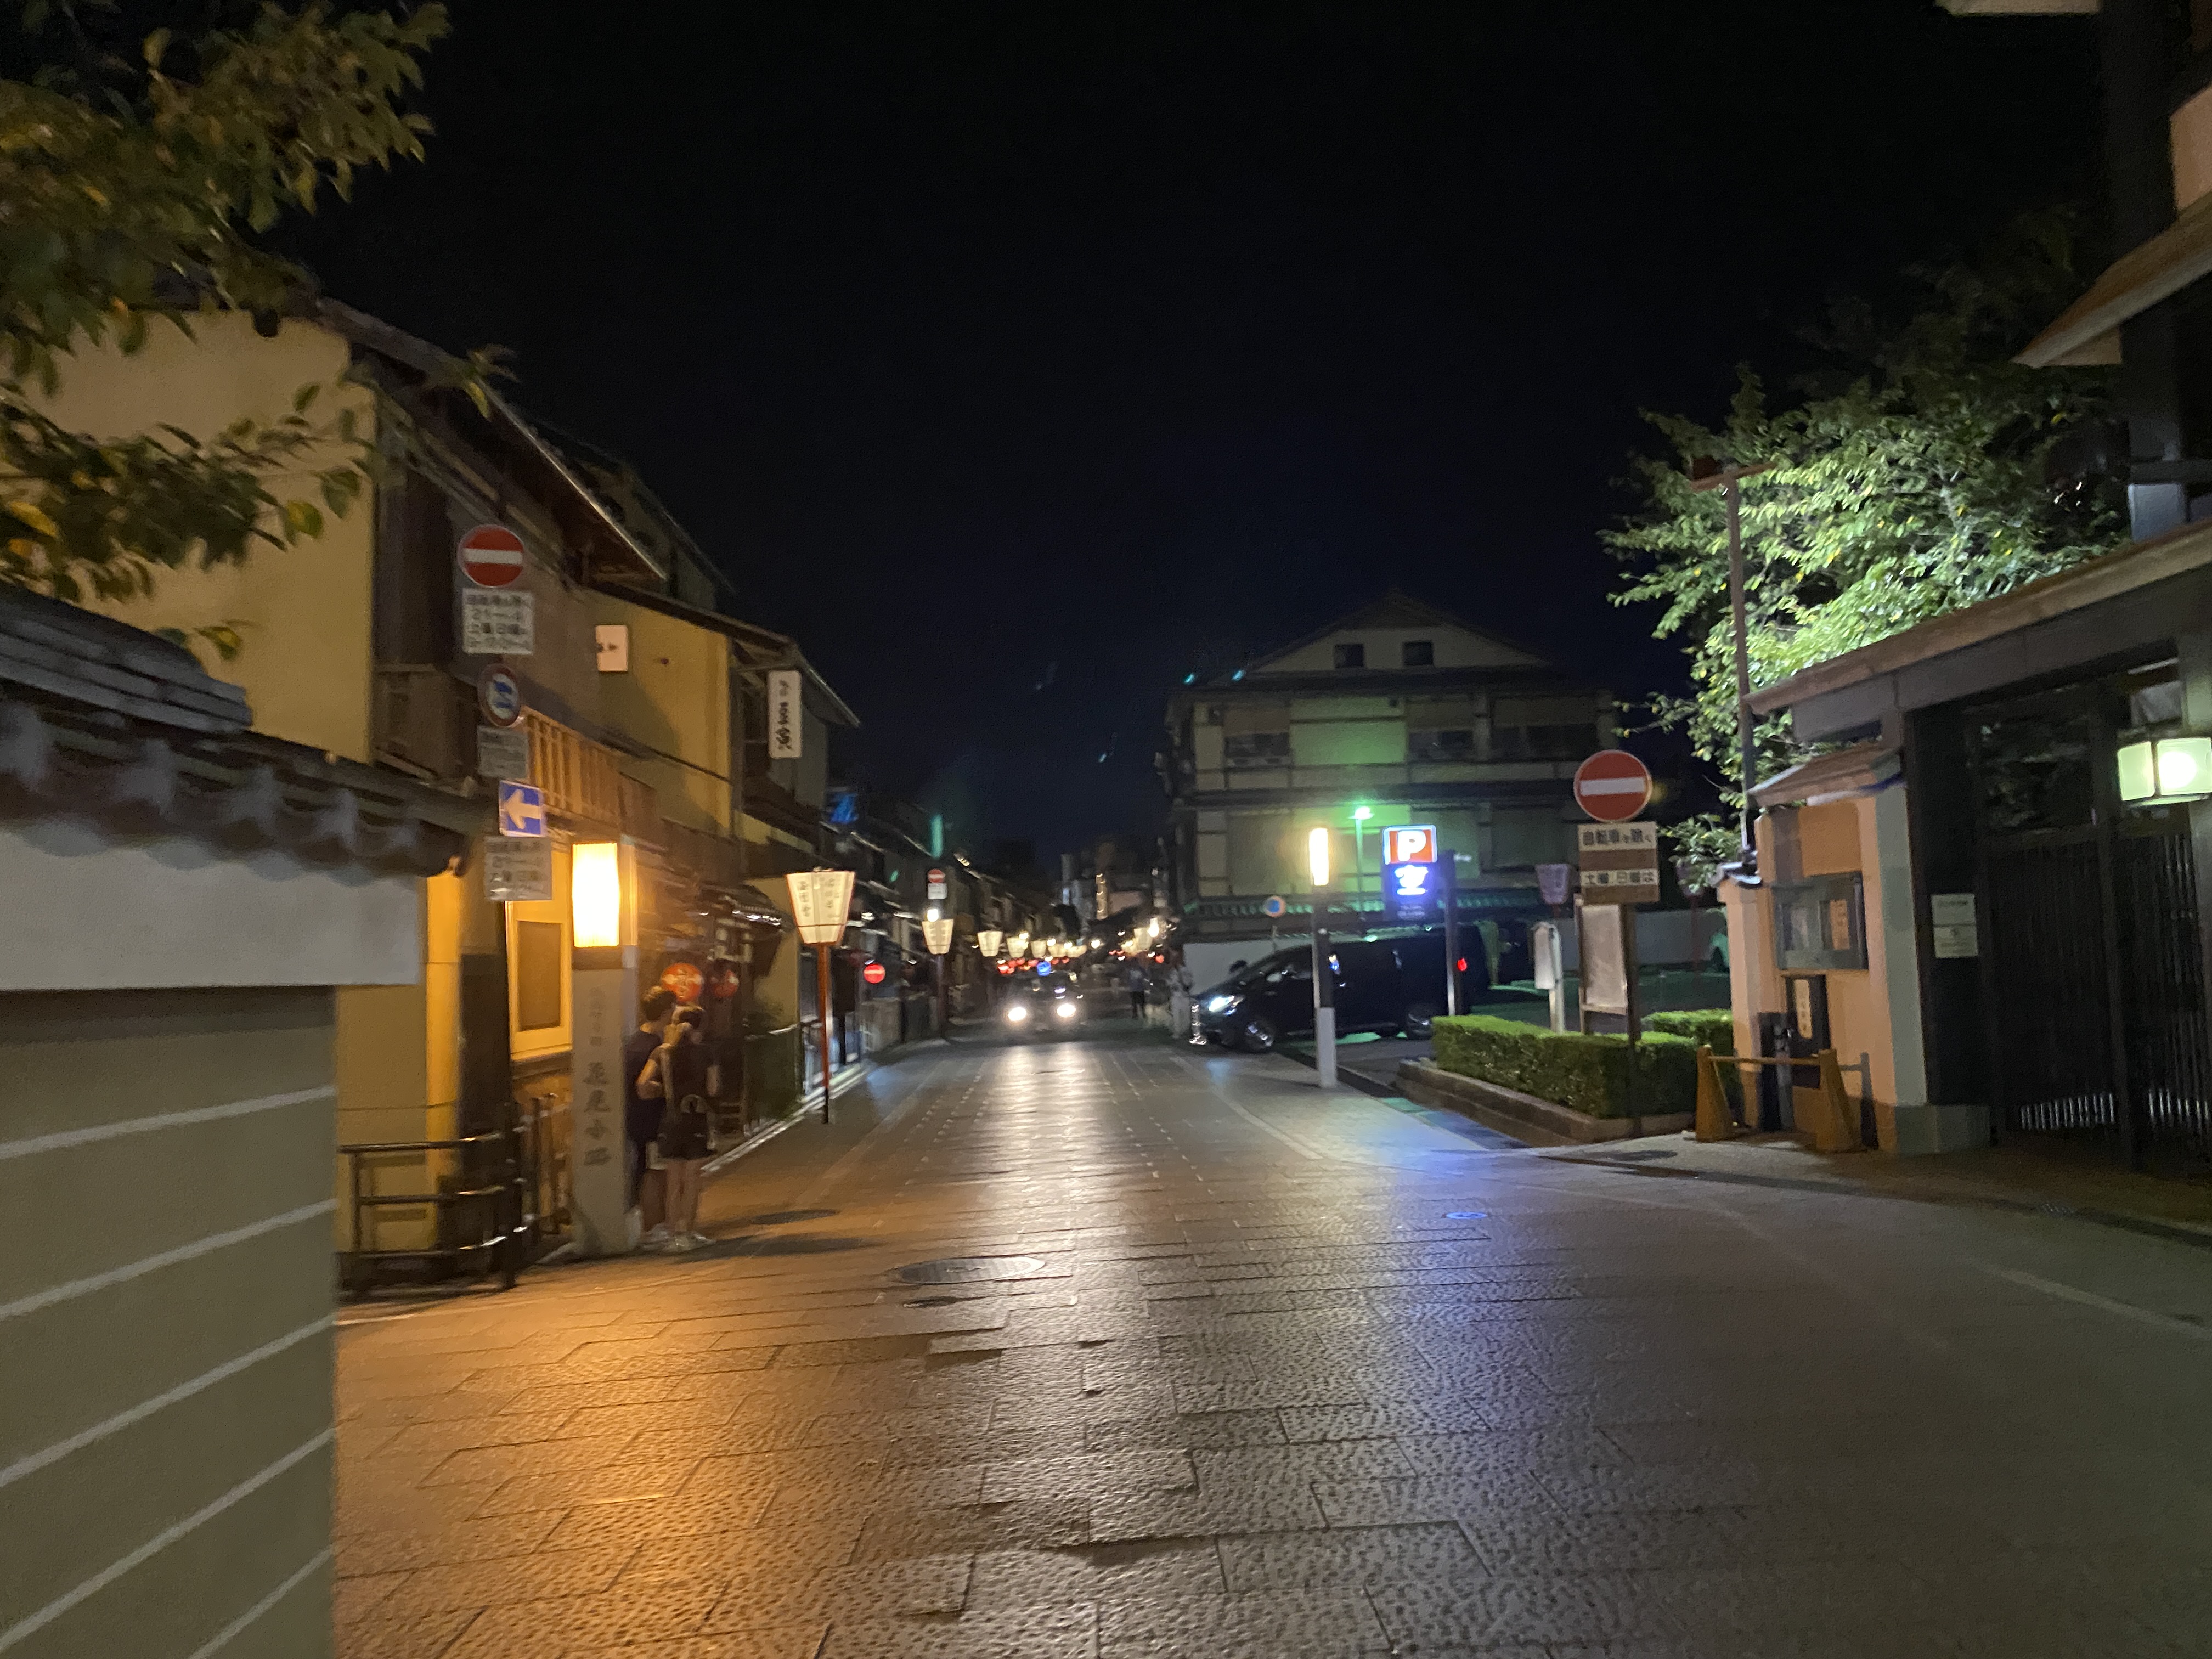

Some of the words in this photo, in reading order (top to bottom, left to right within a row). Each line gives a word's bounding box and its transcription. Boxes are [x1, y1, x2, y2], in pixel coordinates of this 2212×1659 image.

[1397, 830, 1426, 862] P
[1583, 828, 1652, 845] 自転車を除く
